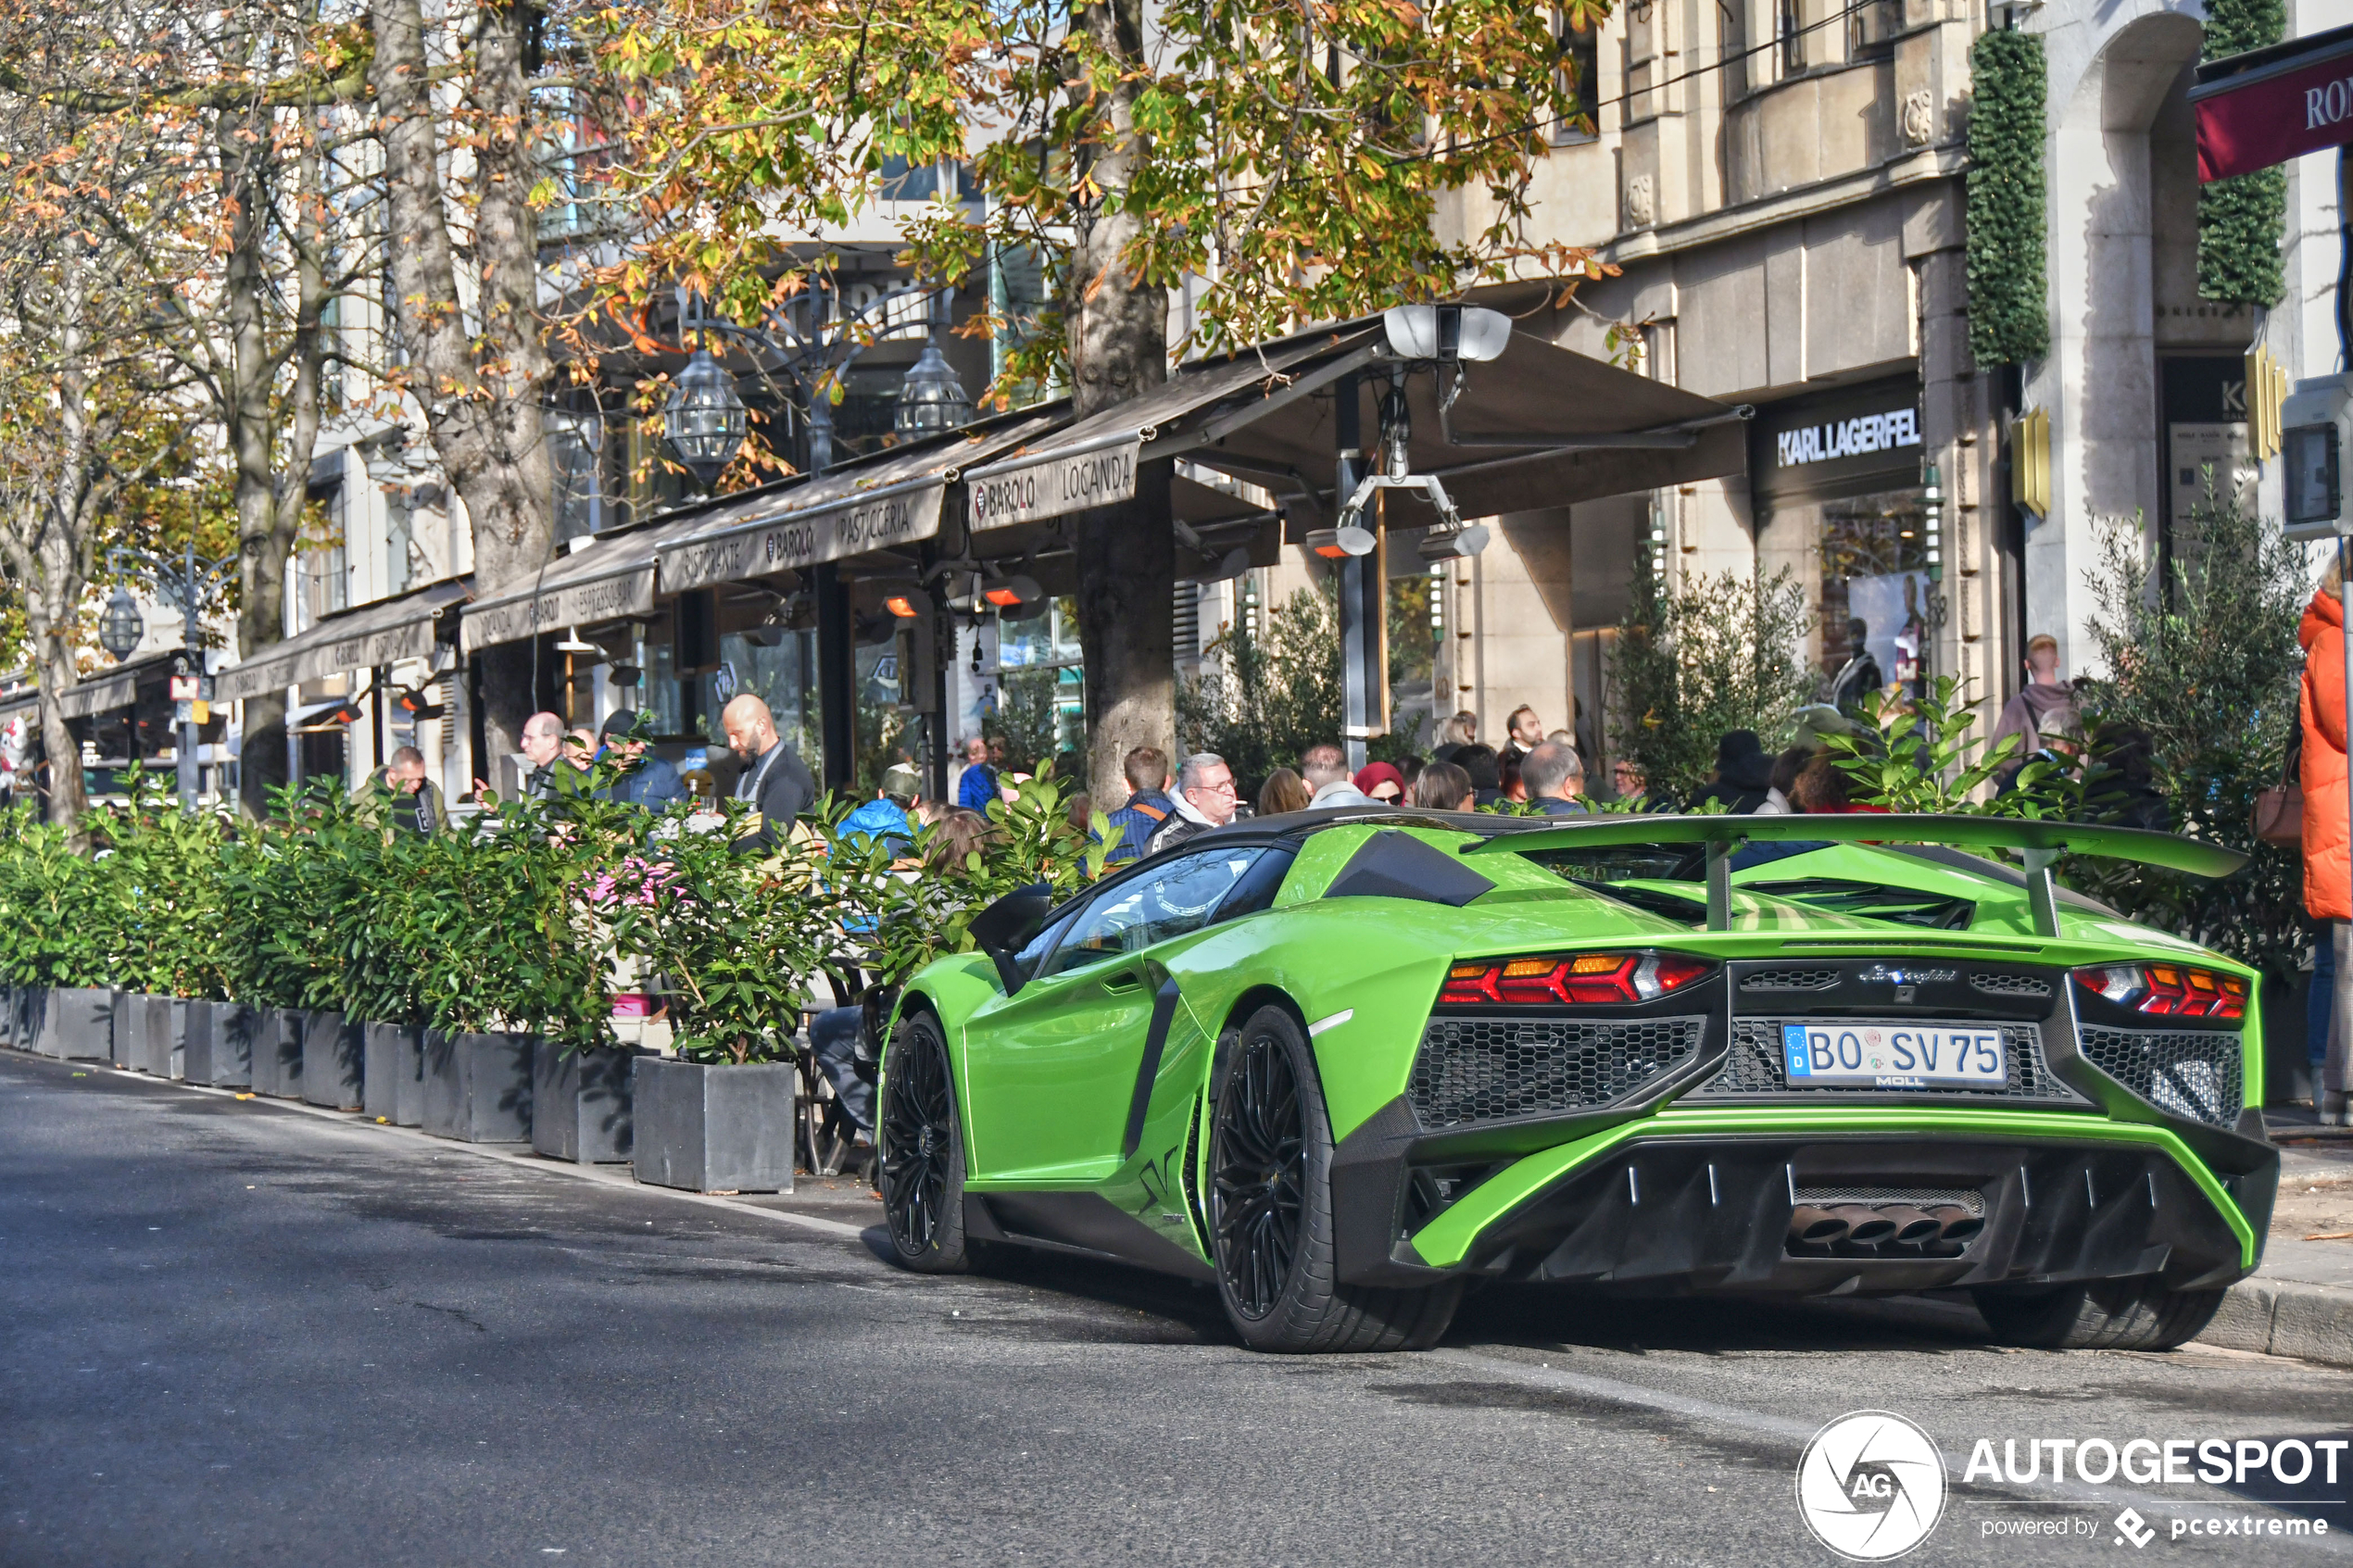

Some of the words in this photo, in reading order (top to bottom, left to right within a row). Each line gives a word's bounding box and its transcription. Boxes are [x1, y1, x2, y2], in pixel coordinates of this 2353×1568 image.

[2221, 380, 2246, 411] K
[1777, 425, 1826, 468] KARL
[1825, 408, 1920, 459] LAGERFEL
[988, 474, 1035, 517] BAROLO
[1063, 453, 1130, 501] LOCANDA
[685, 542, 740, 580] RISTORANTE
[775, 525, 813, 561] BAROLO
[840, 502, 910, 546] PASTICCERIA
[579, 580, 632, 616] ESPRESSO-BAR
[1793, 1056, 1803, 1068] D
[1807, 1031, 1862, 1071] BO
[1891, 1032, 1939, 1072] SV
[1949, 1035, 1998, 1073] 75
[1875, 1076, 1924, 1086] MOLL
